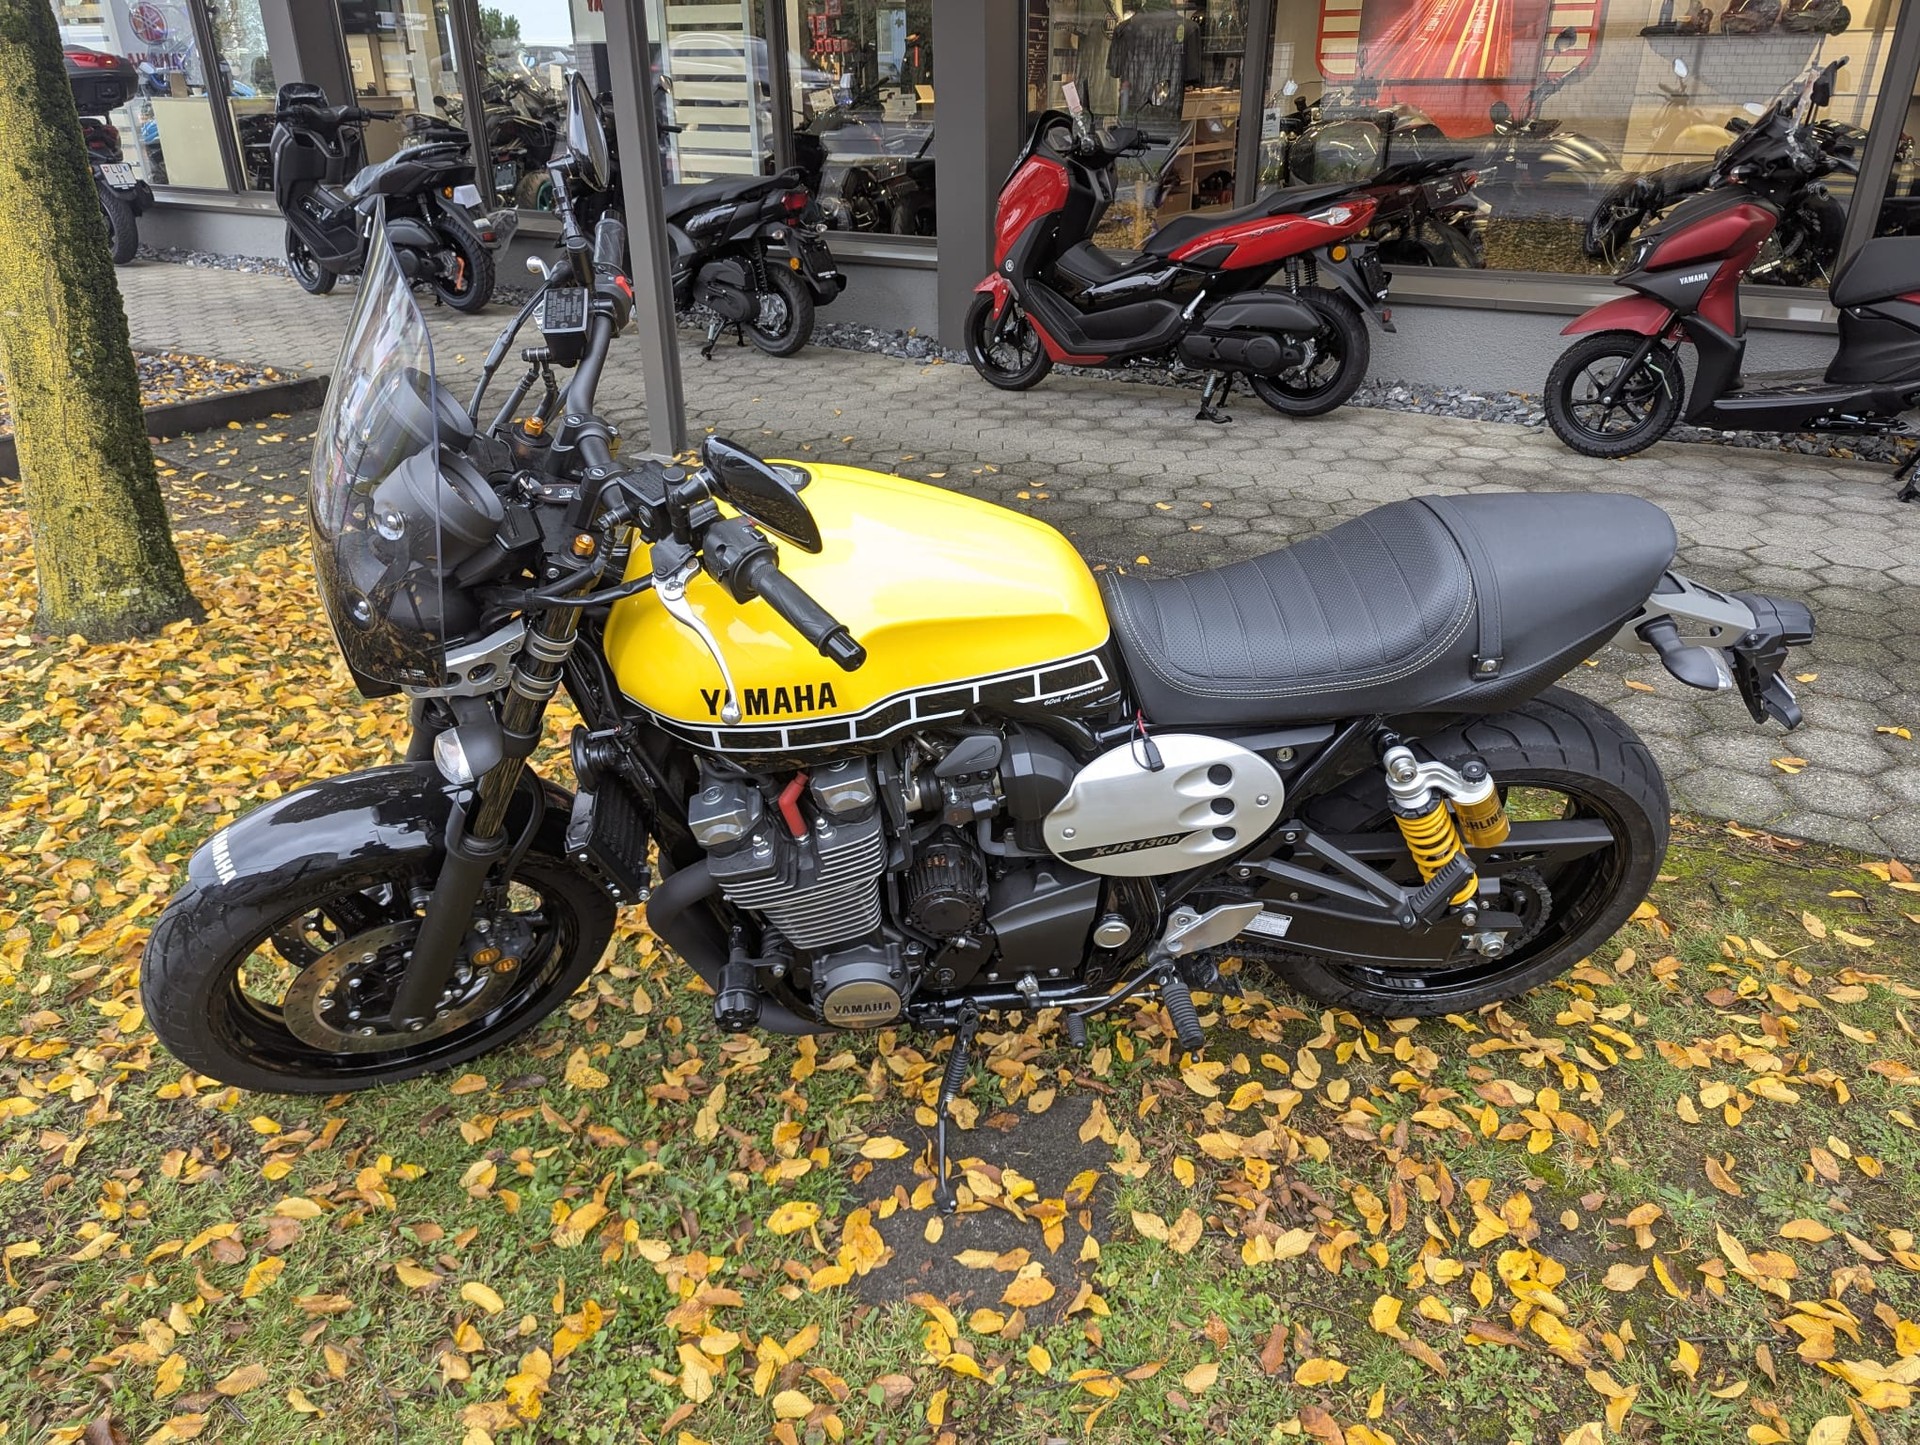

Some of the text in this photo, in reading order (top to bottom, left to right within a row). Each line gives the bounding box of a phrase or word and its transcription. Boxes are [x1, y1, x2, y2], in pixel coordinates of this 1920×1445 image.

[1679, 272, 1708, 285] YAMAHA
[212, 826, 237, 885] YAMAHA
[833, 1001, 892, 1014] YAMAHA
